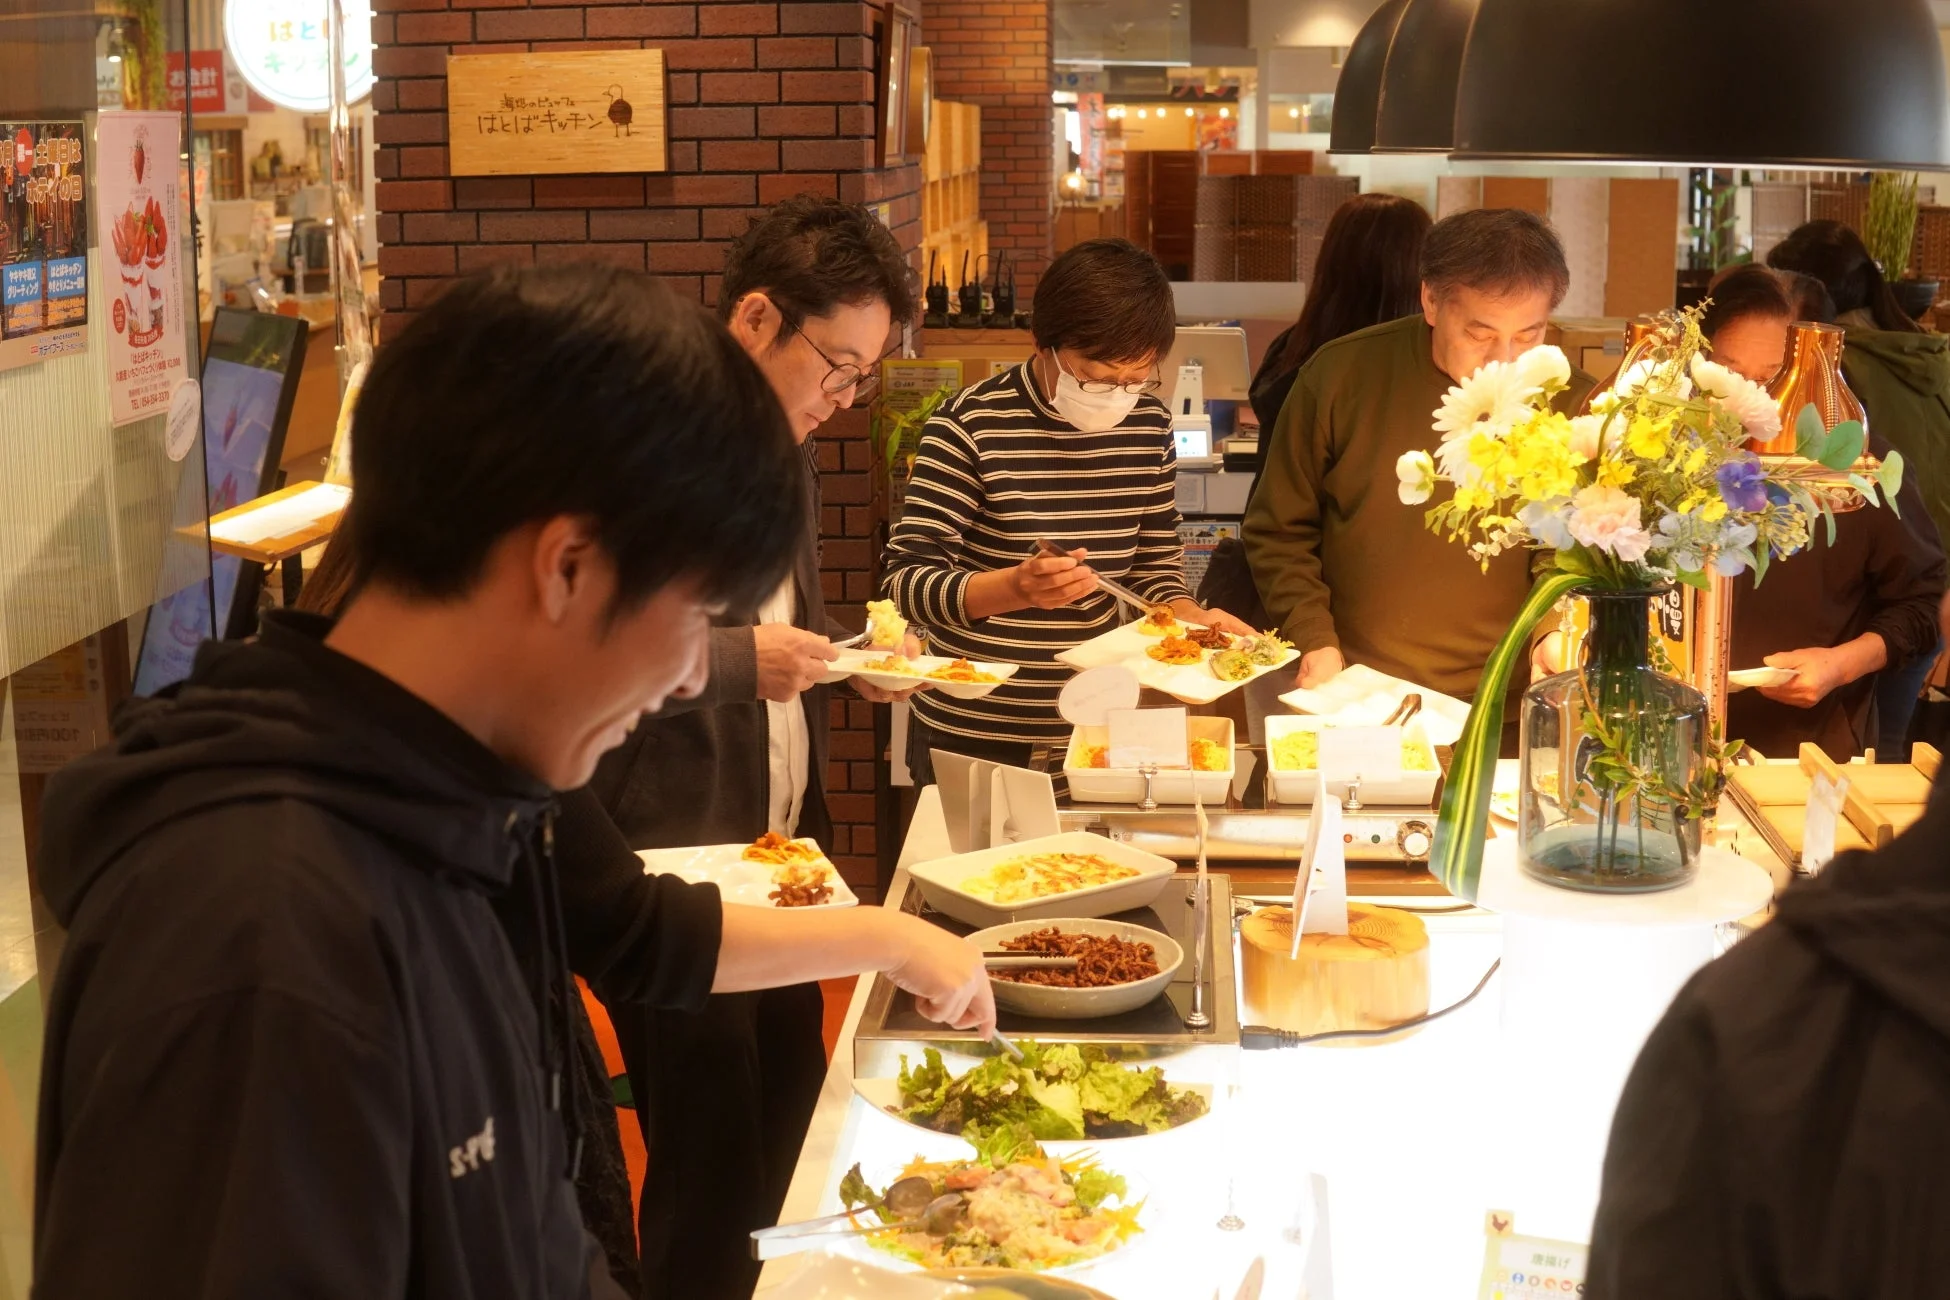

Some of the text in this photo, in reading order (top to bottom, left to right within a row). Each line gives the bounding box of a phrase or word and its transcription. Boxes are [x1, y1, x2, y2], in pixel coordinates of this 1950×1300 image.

[269, 13, 352, 42] はと
[478, 109, 603, 134] はとばキッチン
[26, 174, 83, 204] ホテイの日
[1530, 1253, 1570, 1269] 唐揚げ
